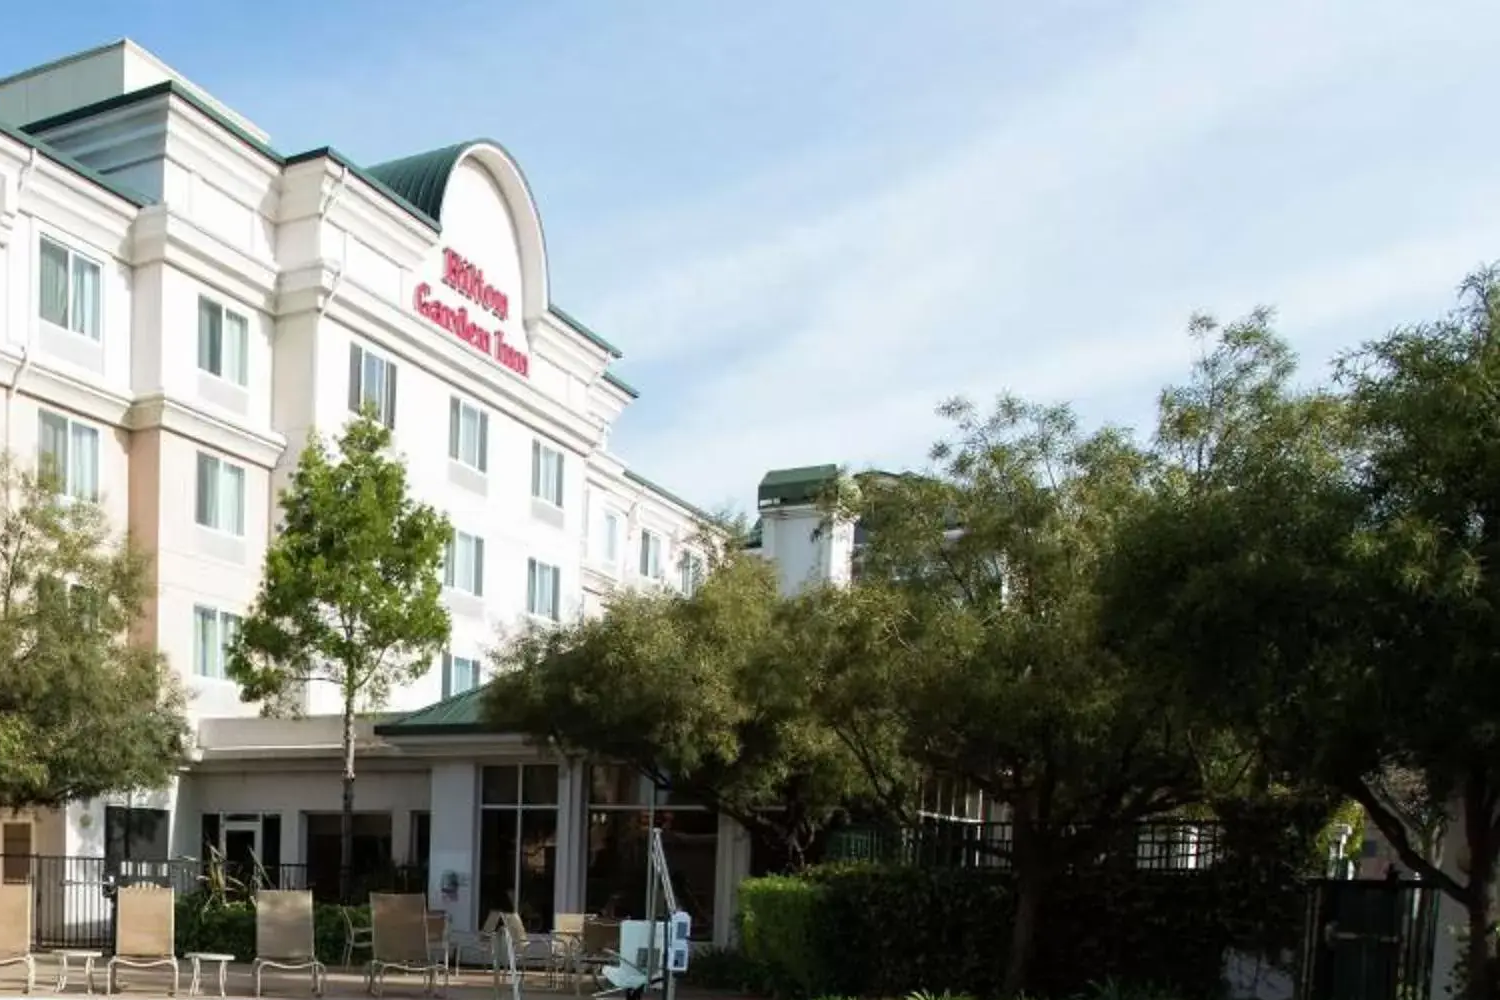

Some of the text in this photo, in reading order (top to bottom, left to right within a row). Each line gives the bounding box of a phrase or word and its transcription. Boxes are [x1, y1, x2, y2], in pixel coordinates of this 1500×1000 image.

[441, 247, 508, 321] Hilton
[414, 282, 529, 378] Garden Inn
